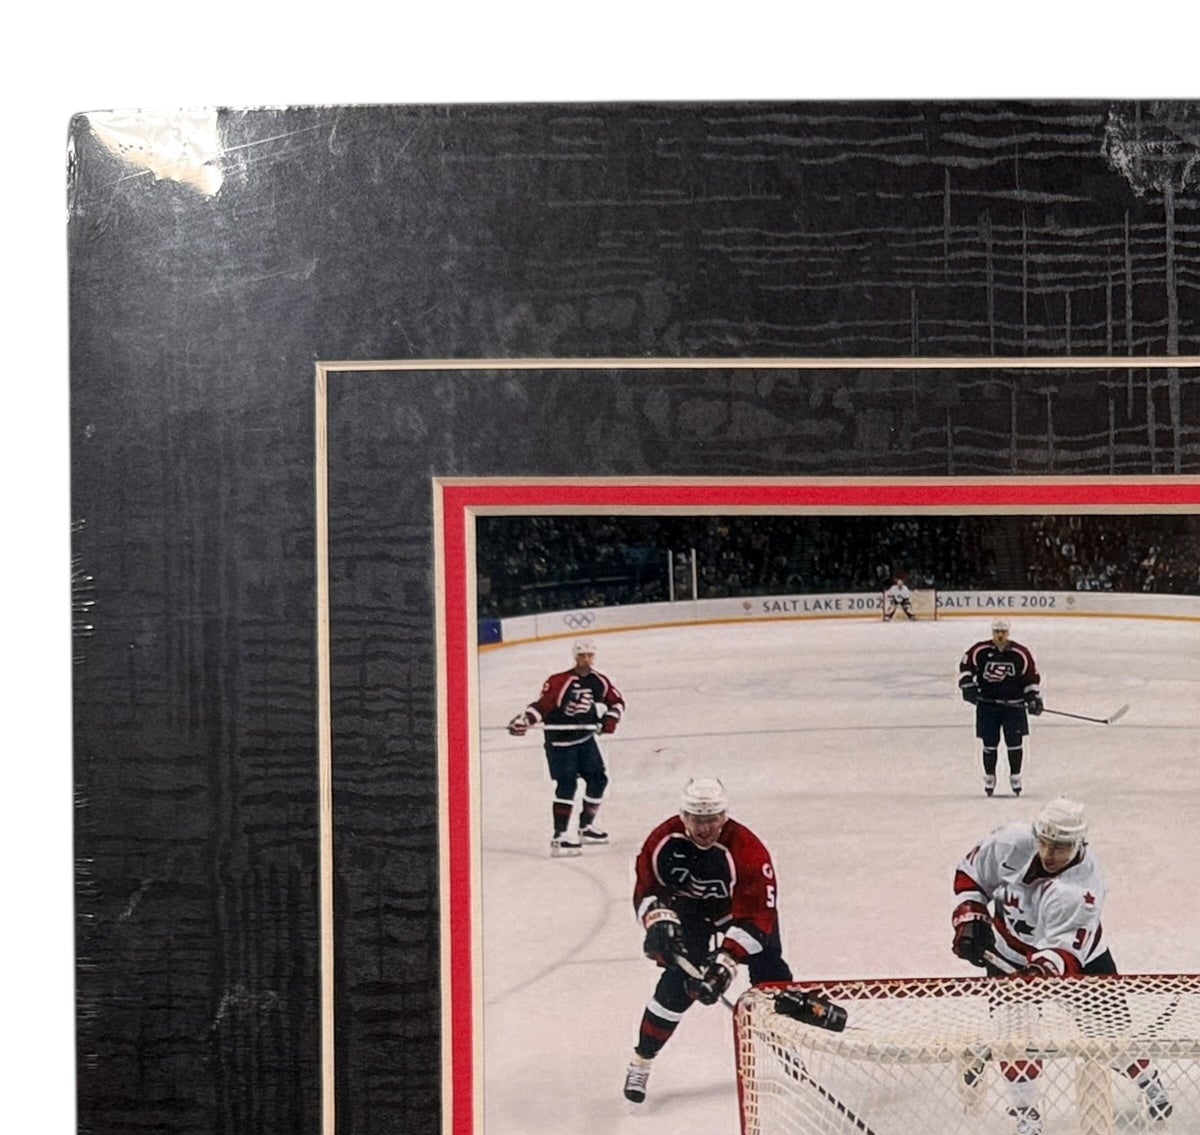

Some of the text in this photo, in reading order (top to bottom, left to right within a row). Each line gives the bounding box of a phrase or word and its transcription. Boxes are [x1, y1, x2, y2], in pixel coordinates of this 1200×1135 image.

[763, 597, 884, 612] SALT LAKE 2002
[936, 595, 1056, 608] SALT LAKE 2002
